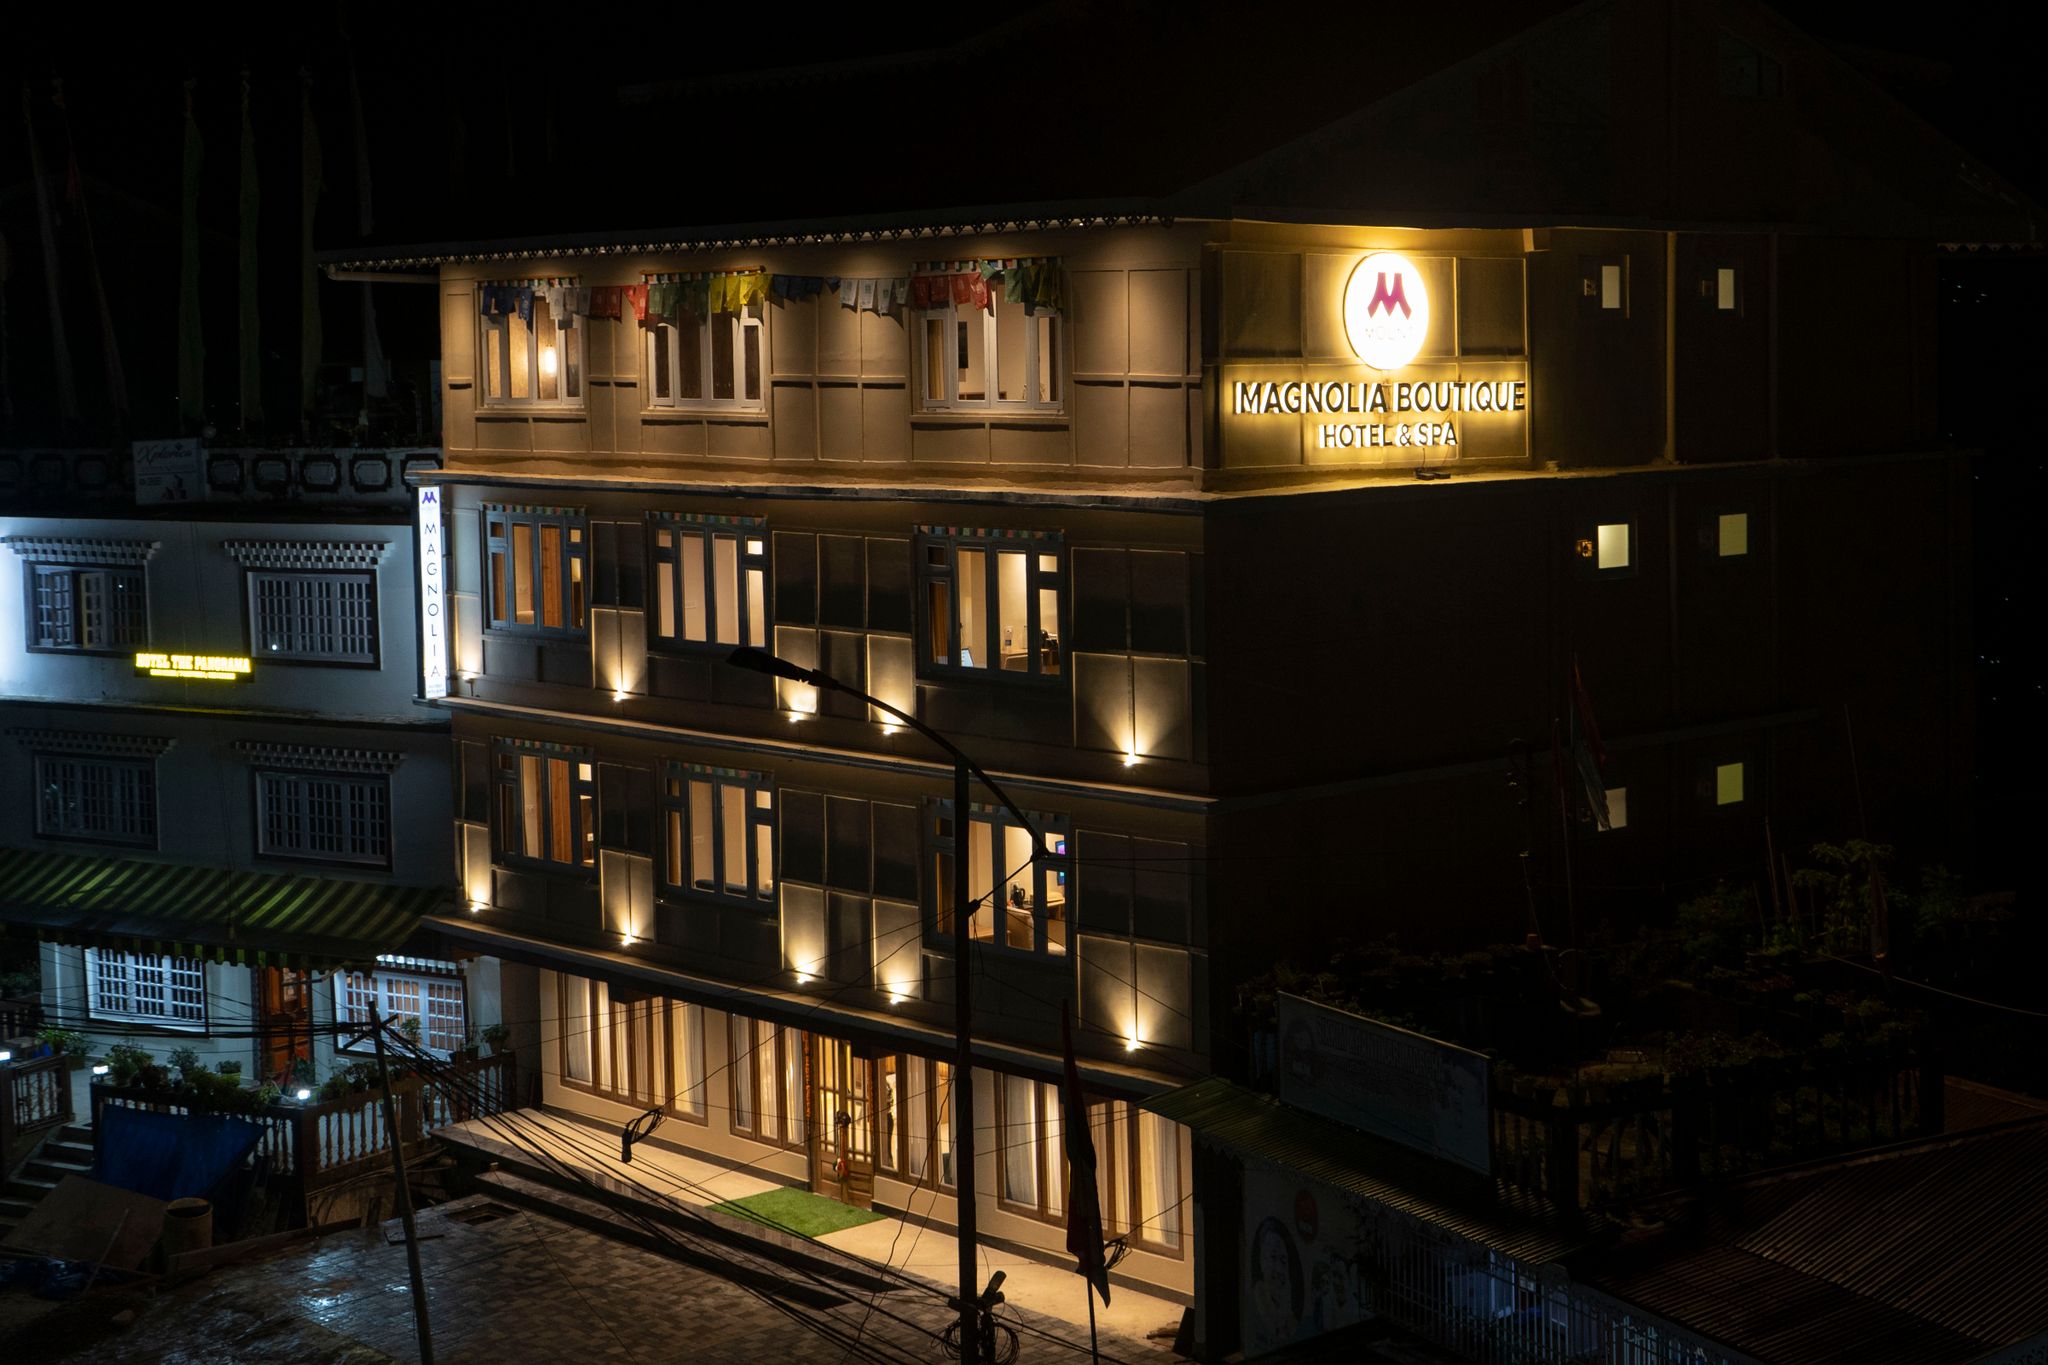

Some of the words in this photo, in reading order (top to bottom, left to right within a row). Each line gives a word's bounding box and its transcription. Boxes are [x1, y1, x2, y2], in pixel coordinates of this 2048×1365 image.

[1234, 382, 1388, 414] MAGNOLIA
[1392, 381, 1526, 412] BOUTIQUE
[1319, 424, 1393, 448] HOTEL
[1396, 424, 1412, 446] &
[1418, 423, 1458, 446] SPA
[424, 523, 441, 677] MAGNOLIA
